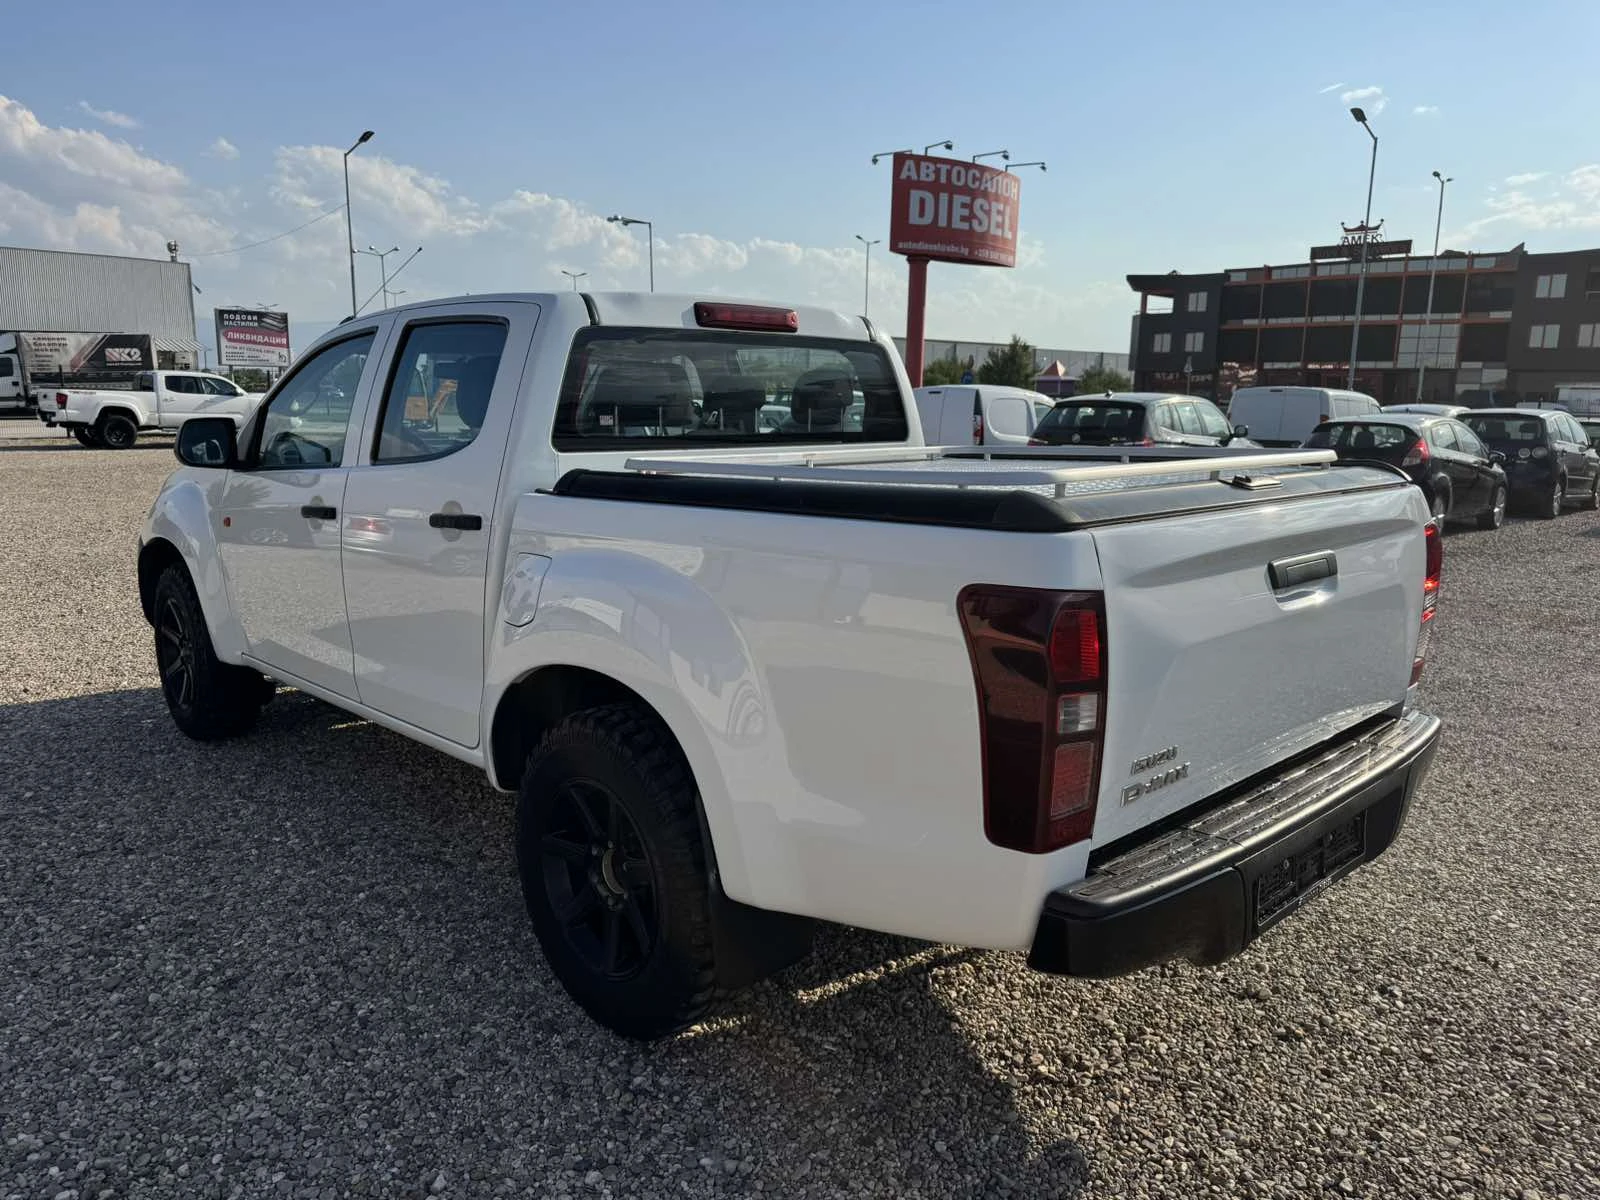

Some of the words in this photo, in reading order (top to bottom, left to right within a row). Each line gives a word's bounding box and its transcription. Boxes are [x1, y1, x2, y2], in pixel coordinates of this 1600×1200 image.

[900, 159, 1018, 201] АВТОСАЛОН
[908, 188, 1012, 240] DIESEL
[227, 331, 287, 345] ЛИКВИДАЦИЯ
[1130, 744, 1179, 776] ISUZU
